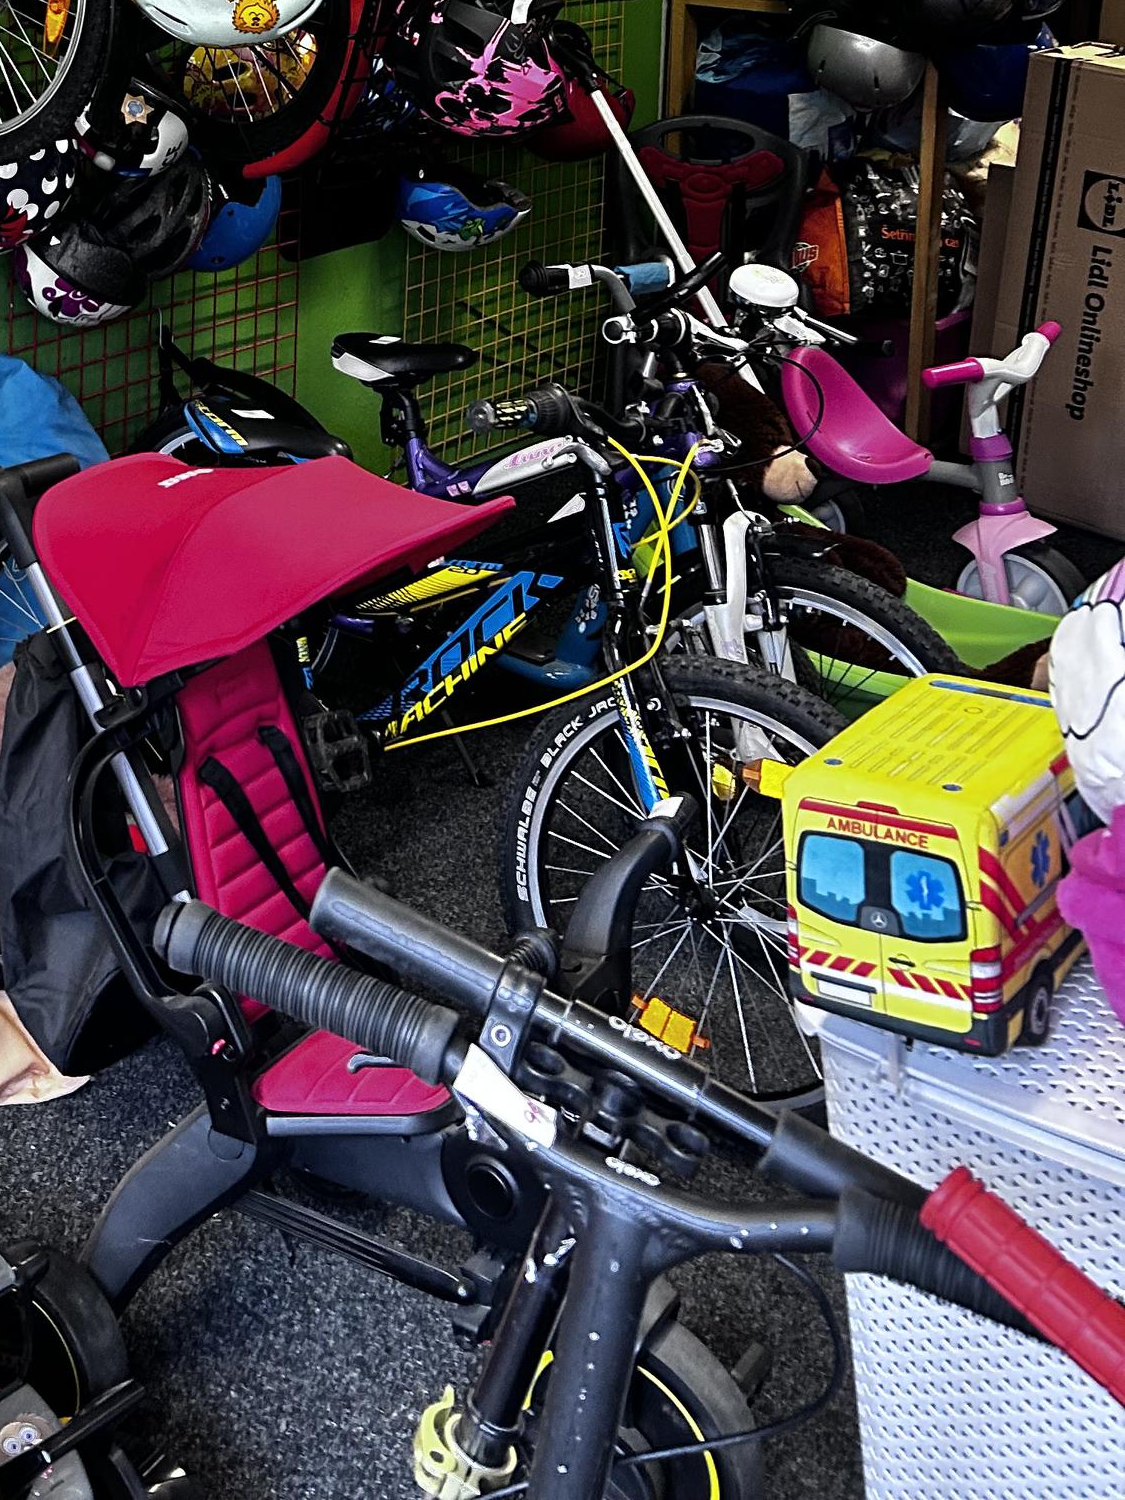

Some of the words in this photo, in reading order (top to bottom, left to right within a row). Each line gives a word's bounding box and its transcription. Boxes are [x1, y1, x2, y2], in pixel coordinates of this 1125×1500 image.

[1087, 243, 1113, 289] Lidl
[1065, 292, 1106, 422] Onlineshop
[515, 786, 538, 903] SCHWALBE
[539, 714, 584, 769] BLACK
[588, 696, 617, 719] JAC
[826, 816, 929, 849] AMBULANCE
